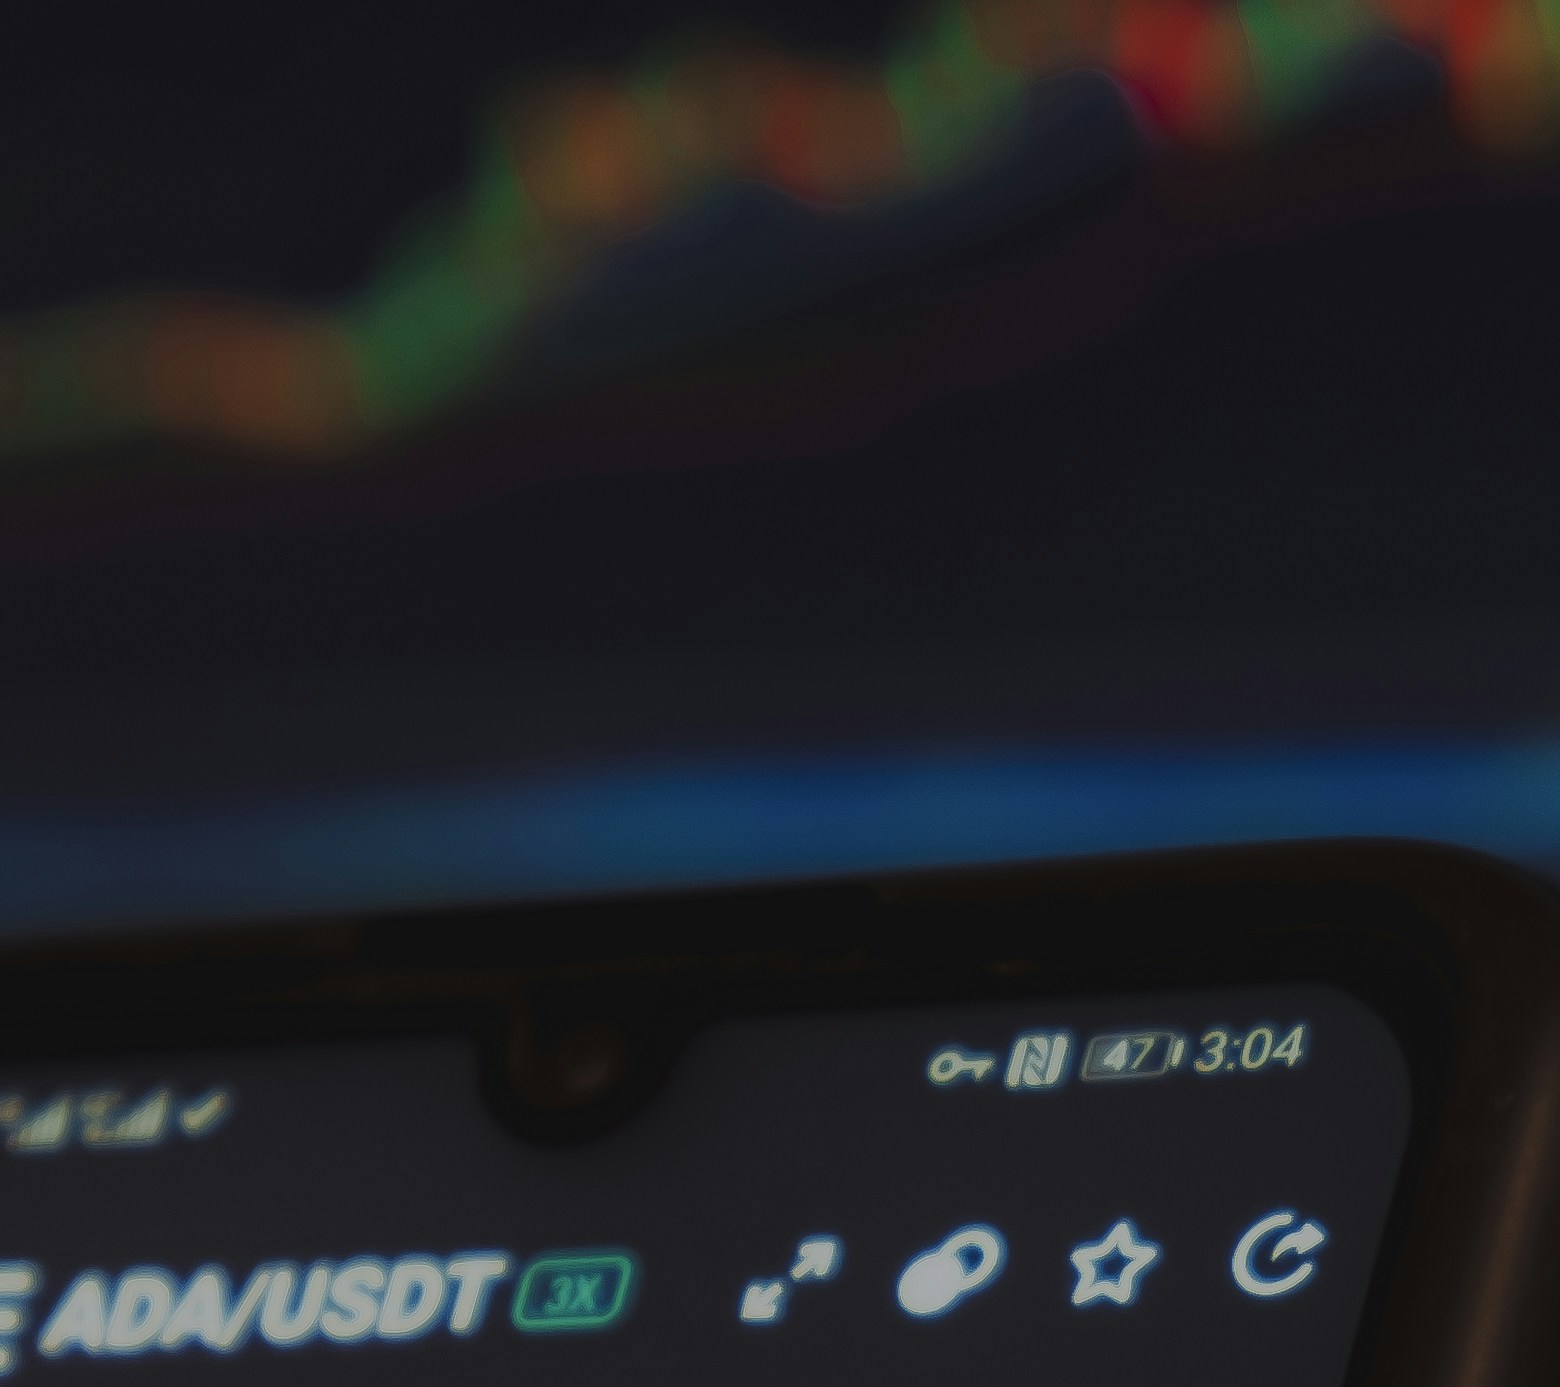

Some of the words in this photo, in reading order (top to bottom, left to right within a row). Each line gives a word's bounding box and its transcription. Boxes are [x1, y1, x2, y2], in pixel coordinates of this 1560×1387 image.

[1193, 1022, 1306, 1074] 3:04
[38, 1256, 510, 1355] ADA/USDT
[543, 1272, 603, 1316] 3X
